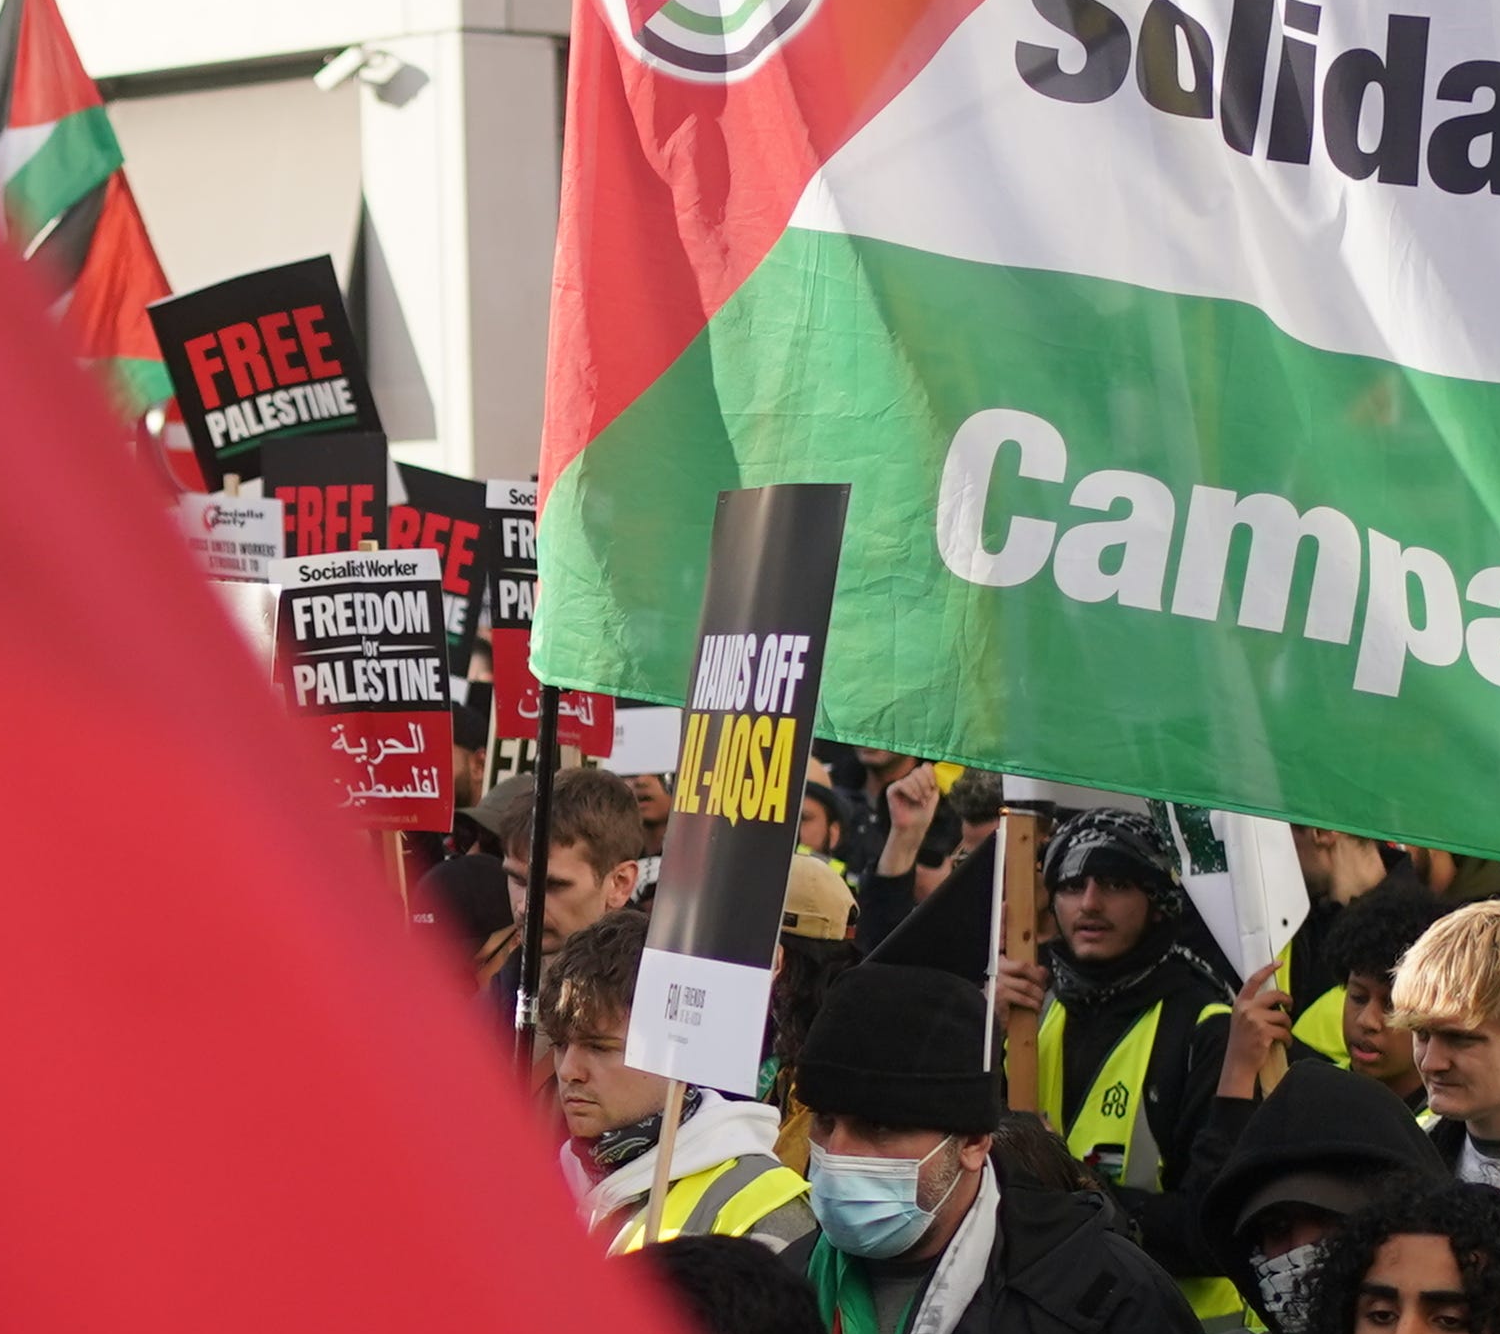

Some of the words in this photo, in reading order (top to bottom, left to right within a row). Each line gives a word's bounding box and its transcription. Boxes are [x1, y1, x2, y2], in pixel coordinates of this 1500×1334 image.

[185, 305, 343, 410] FREE
[205, 378, 358, 449] PALESTINE
[274, 483, 375, 556] FREE
[299, 560, 366, 583] Socialist
[366, 559, 418, 578] Worker
[291, 589, 432, 642] FREEDOM
[361, 635, 379, 658] for
[293, 657, 445, 708] PALESTINE
[692, 632, 757, 711] HANDS
[753, 633, 810, 715] OFF
[330, 721, 426, 764] الحرية
[674, 713, 797, 827] AL-AQSA
[664, 982, 682, 1021] FOA
